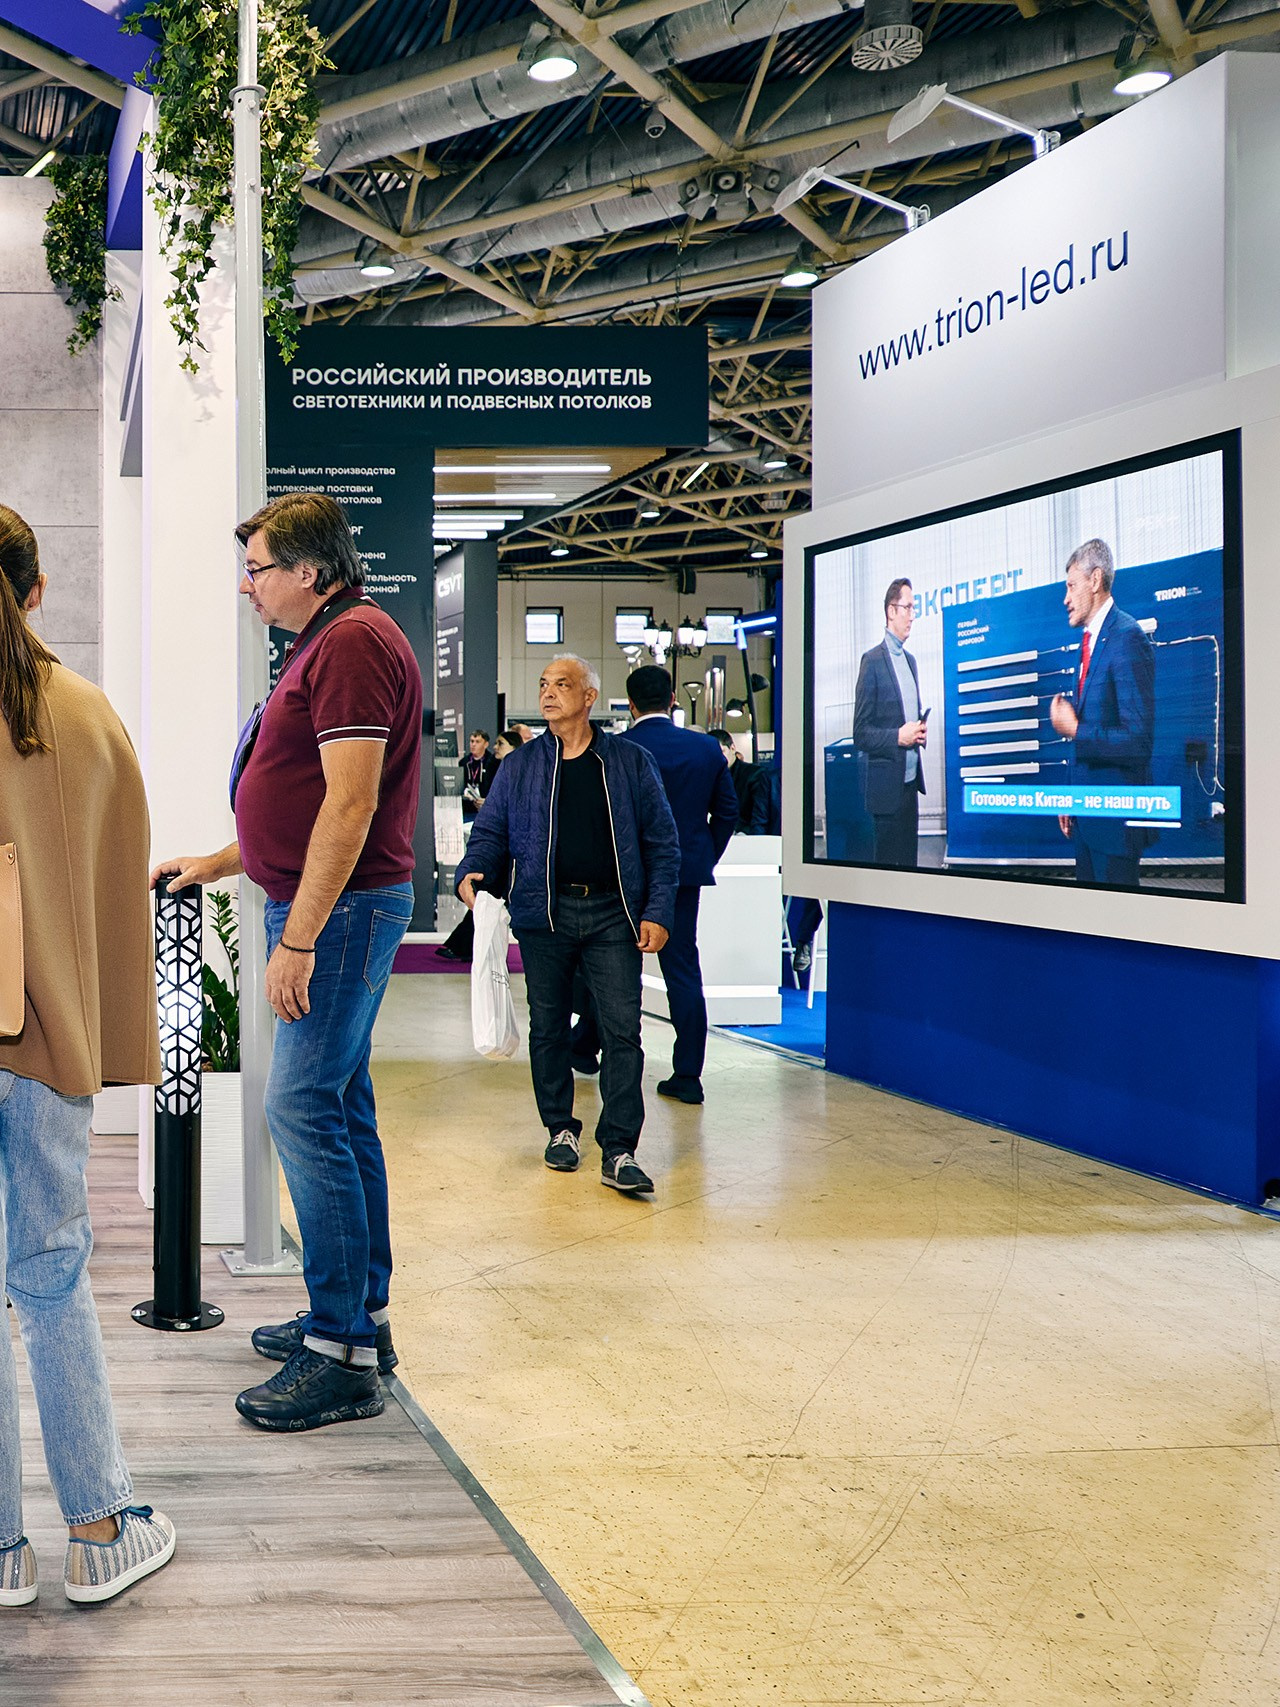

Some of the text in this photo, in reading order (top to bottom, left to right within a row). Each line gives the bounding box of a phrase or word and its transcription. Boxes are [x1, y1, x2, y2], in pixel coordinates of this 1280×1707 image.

[859, 230, 1129, 380] www.trion-led.ru
[291, 362, 652, 388] РОССИЙСКИЙ ПРОИЗВОДИТЕЛЬ
[292, 395, 652, 411] СВЕТОТЕХНИКИ И ПОДВЕСНЫХ ПОТОЛКОВ
[265, 464, 396, 477] олный цикл производства
[327, 485, 374, 493] поставки
[336, 496, 382, 505] потолков
[366, 573, 417, 583] тельность
[437, 572, 463, 598] CSVT
[363, 583, 400, 594] ронной
[1154, 586, 1187, 602] TRION
[970, 790, 1017, 807] Готовое
[1018, 794, 1033, 807] из
[1035, 791, 1073, 808] Китая
[1084, 795, 1102, 808] не
[1104, 795, 1134, 810] наш
[1136, 795, 1171, 813] путь
